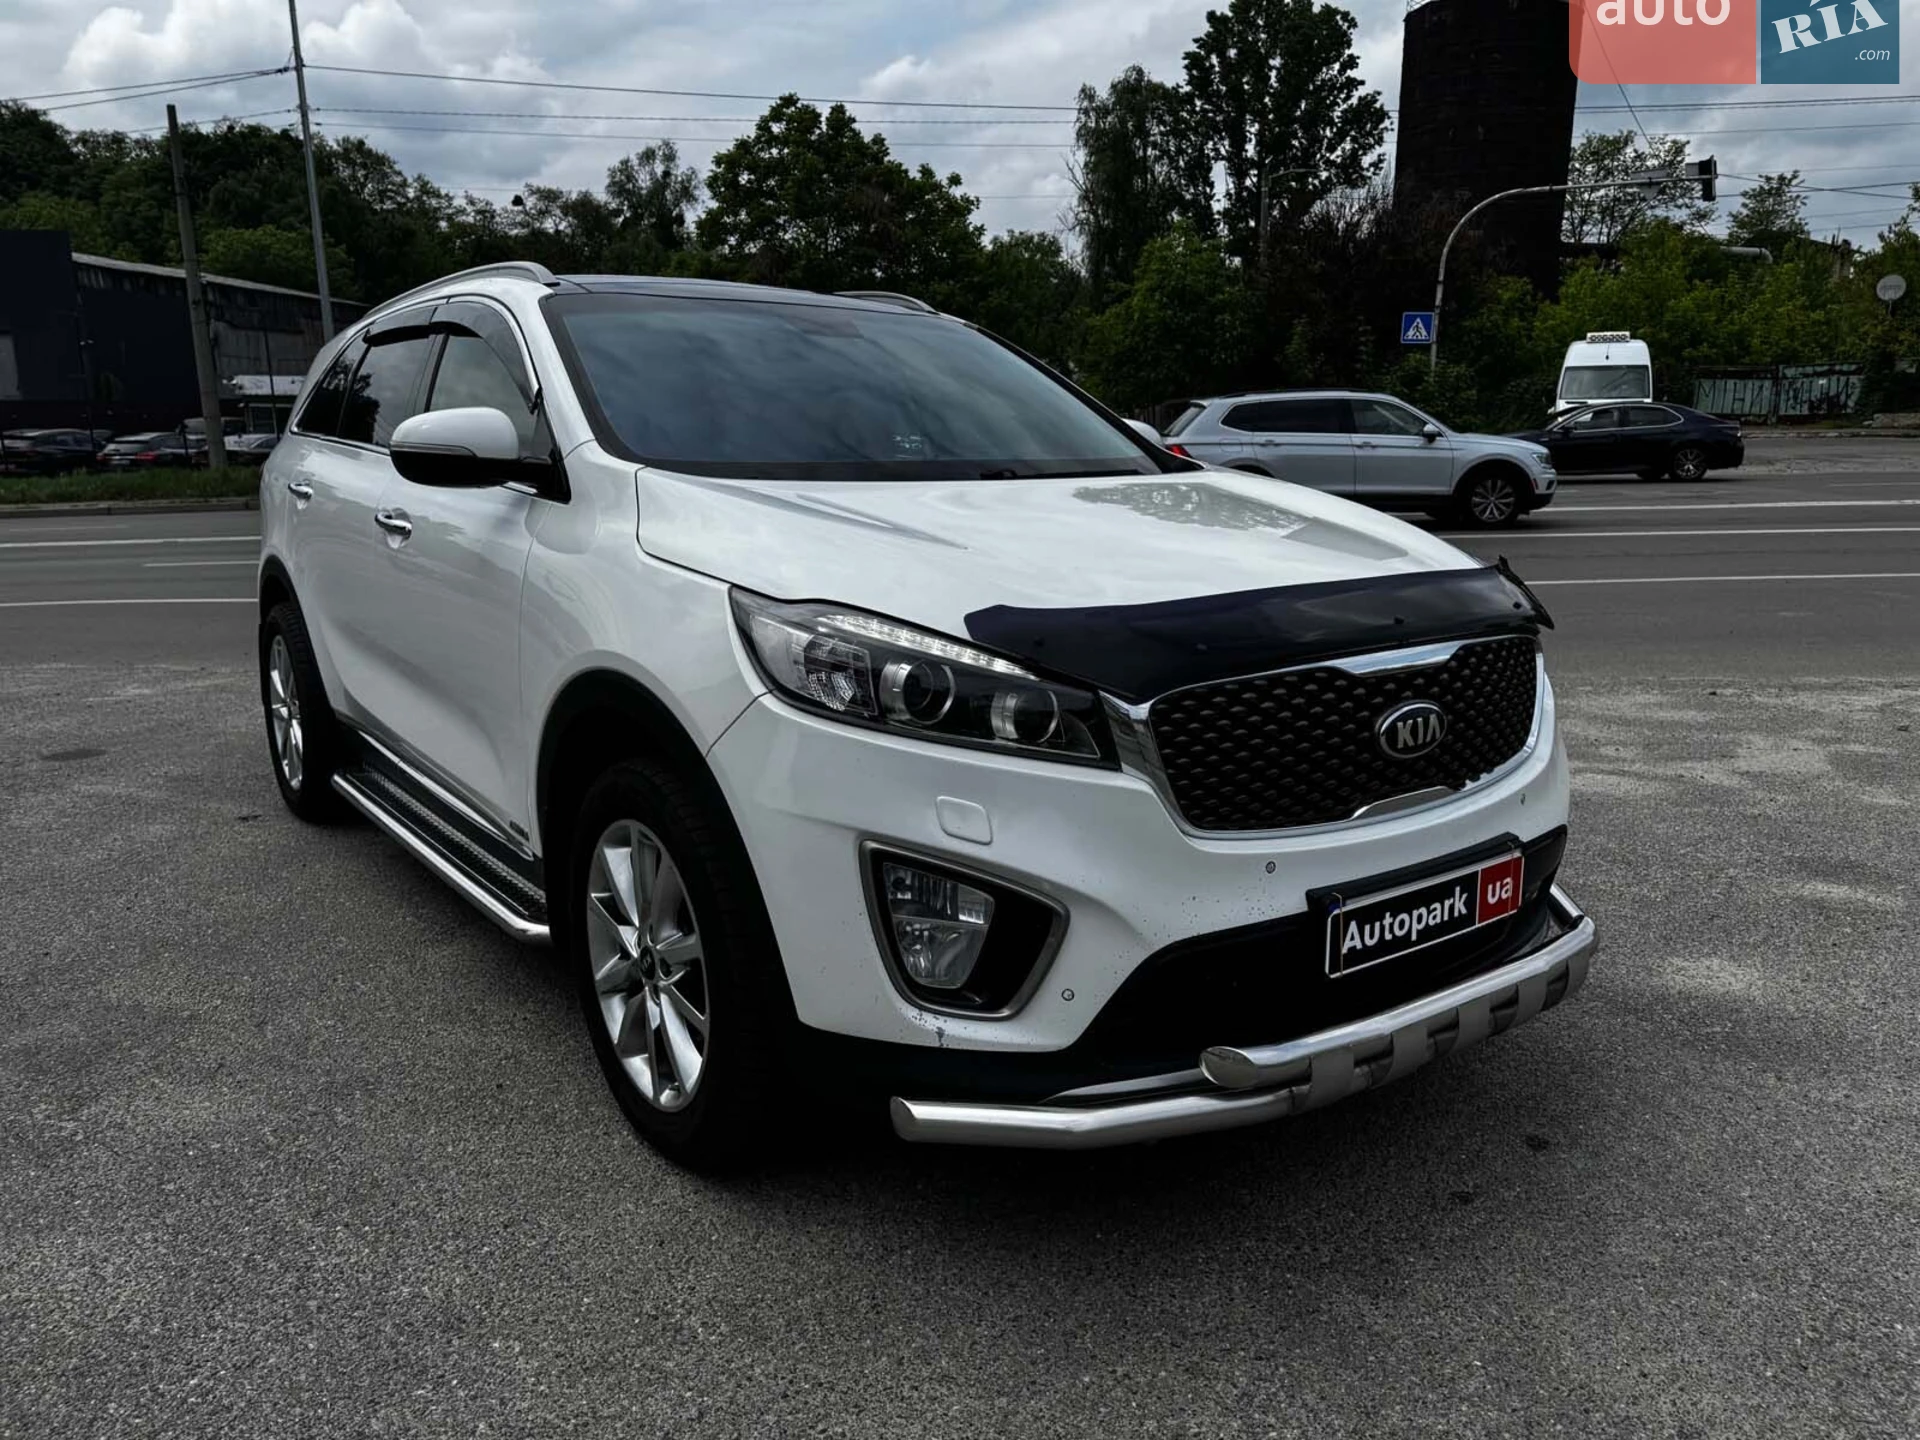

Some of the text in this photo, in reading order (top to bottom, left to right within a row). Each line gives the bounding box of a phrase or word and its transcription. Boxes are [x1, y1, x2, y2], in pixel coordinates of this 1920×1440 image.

[1397, 713, 1441, 749] KIA
[1342, 876, 1513, 954] Autopark ua
